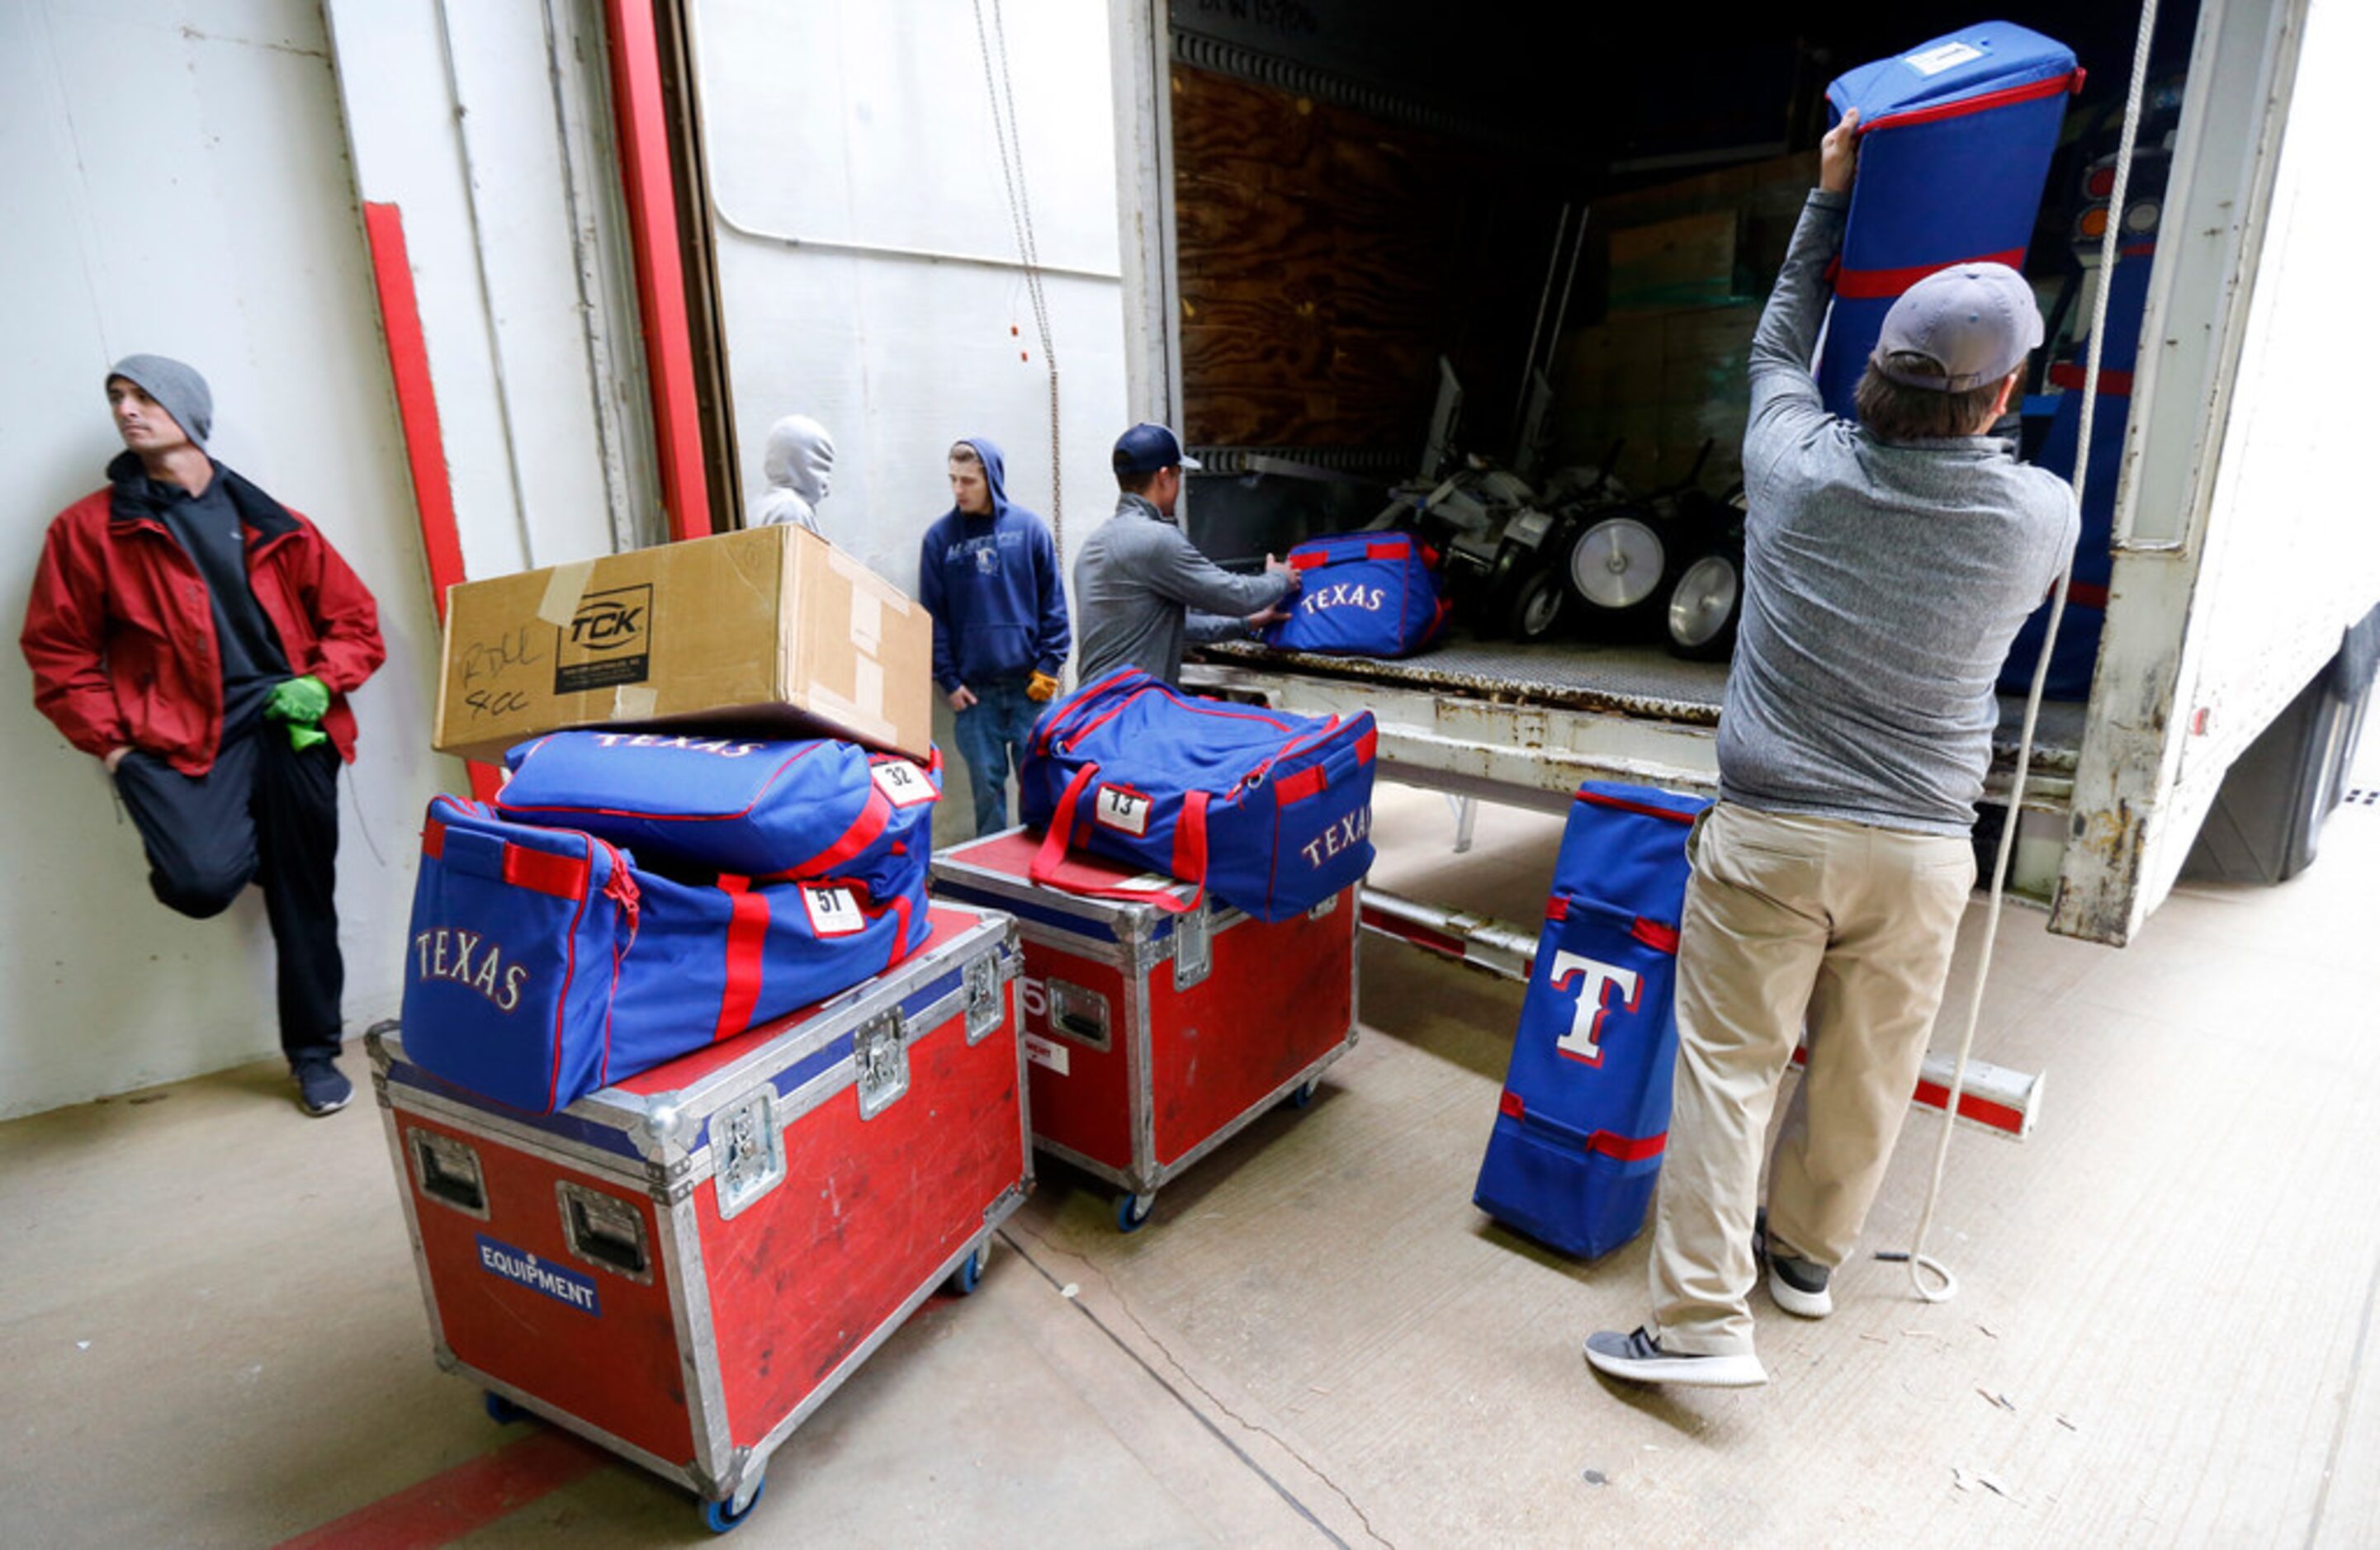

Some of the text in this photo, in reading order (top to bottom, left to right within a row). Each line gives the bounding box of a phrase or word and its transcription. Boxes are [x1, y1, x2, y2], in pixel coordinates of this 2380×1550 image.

[1301, 582, 1385, 615] TEXAS
[570, 605, 644, 642] TCK
[591, 733, 766, 758] TEXAS
[885, 766, 912, 787] 32
[1111, 792, 1133, 815] 13
[1302, 806, 1372, 869] TEXA
[814, 886, 842, 914] 51
[416, 929, 528, 1012] TEXAS
[1550, 948, 1645, 1070] T
[480, 1244, 594, 1310] EQUIPMENT
